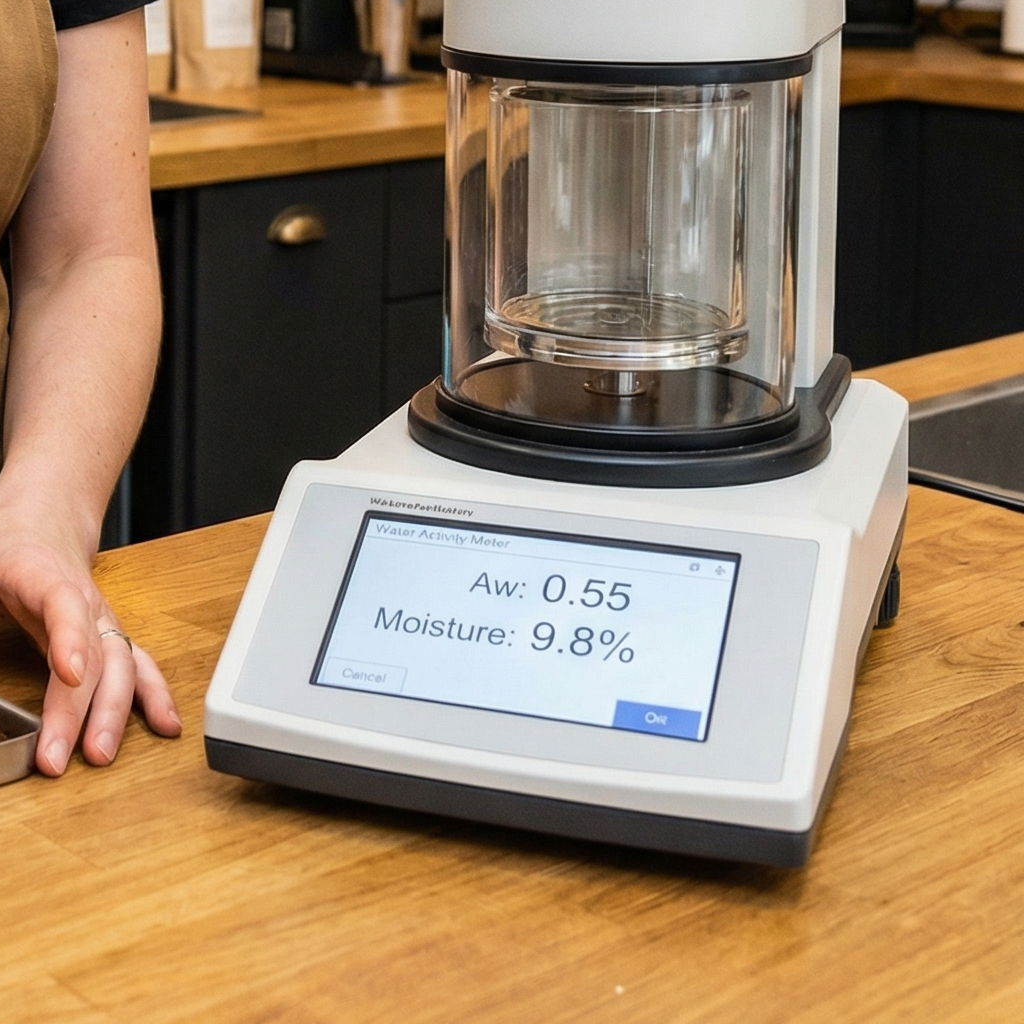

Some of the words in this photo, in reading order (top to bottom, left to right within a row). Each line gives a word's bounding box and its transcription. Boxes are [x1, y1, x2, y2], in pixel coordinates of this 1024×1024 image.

[469, 572, 526, 599] Aw:
[542, 574, 633, 612] 0.55
[374, 607, 516, 647] Moisture:
[530, 621, 636, 664] 9.8%
